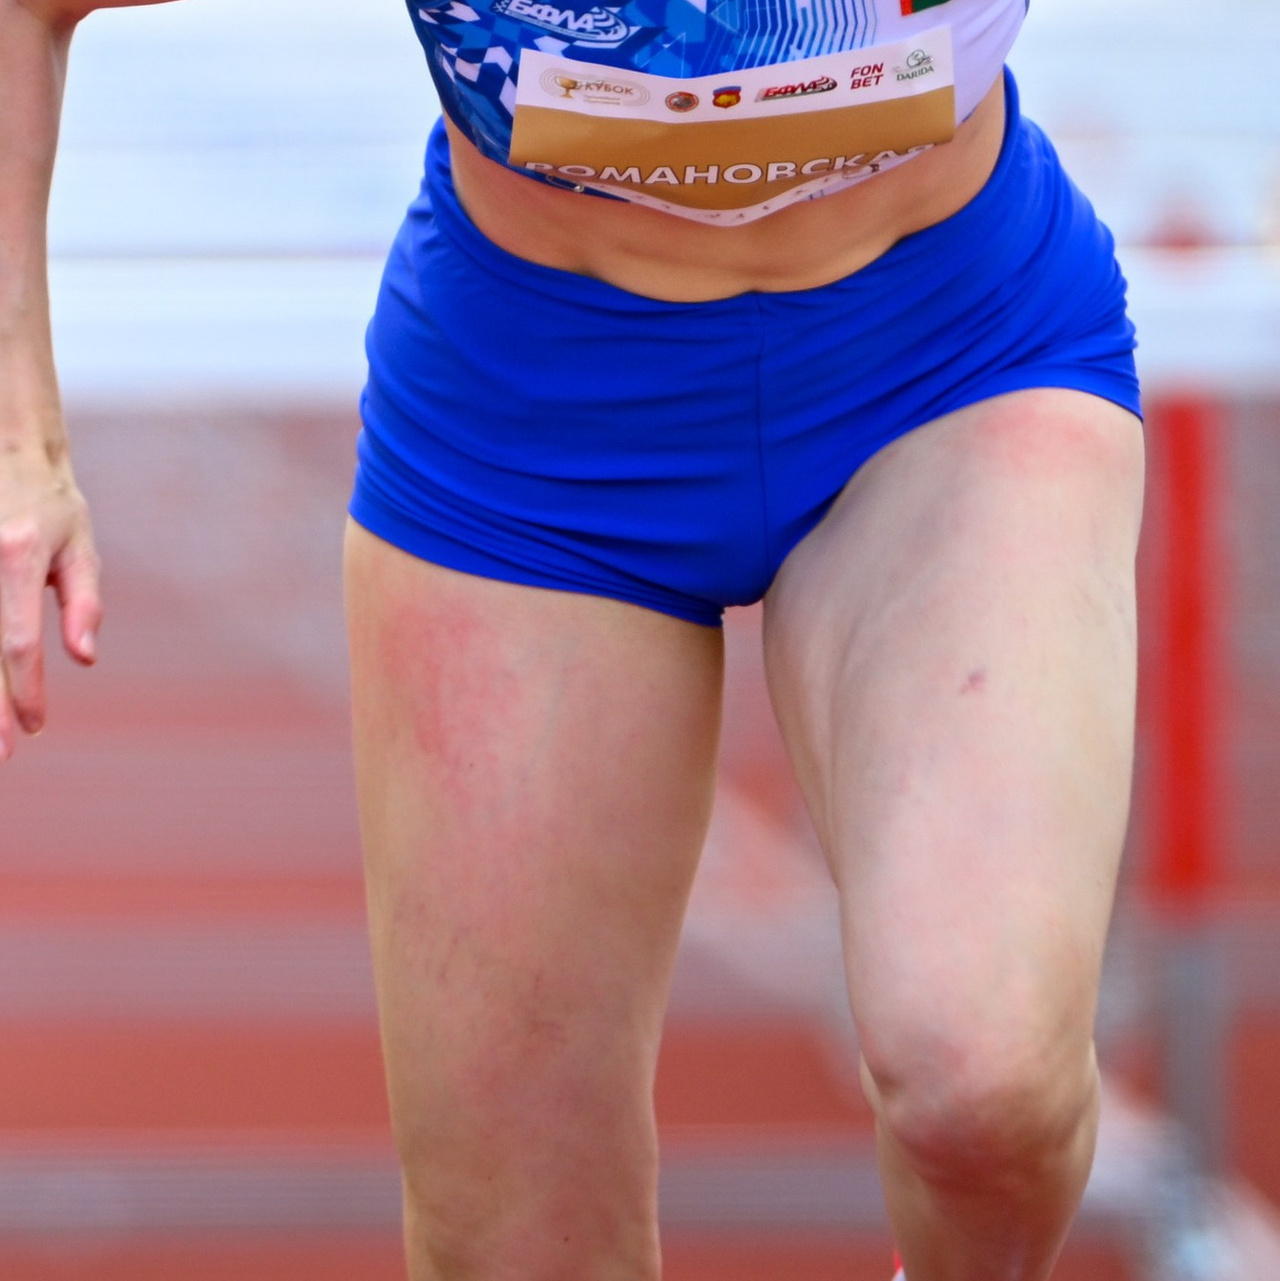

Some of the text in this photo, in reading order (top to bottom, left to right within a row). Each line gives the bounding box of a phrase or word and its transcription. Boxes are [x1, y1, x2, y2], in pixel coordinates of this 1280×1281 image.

[850, 63, 884, 79] FON
[896, 65, 935, 82] DARIDA
[584, 81, 634, 96] КУБОК
[850, 74, 884, 90] BET
